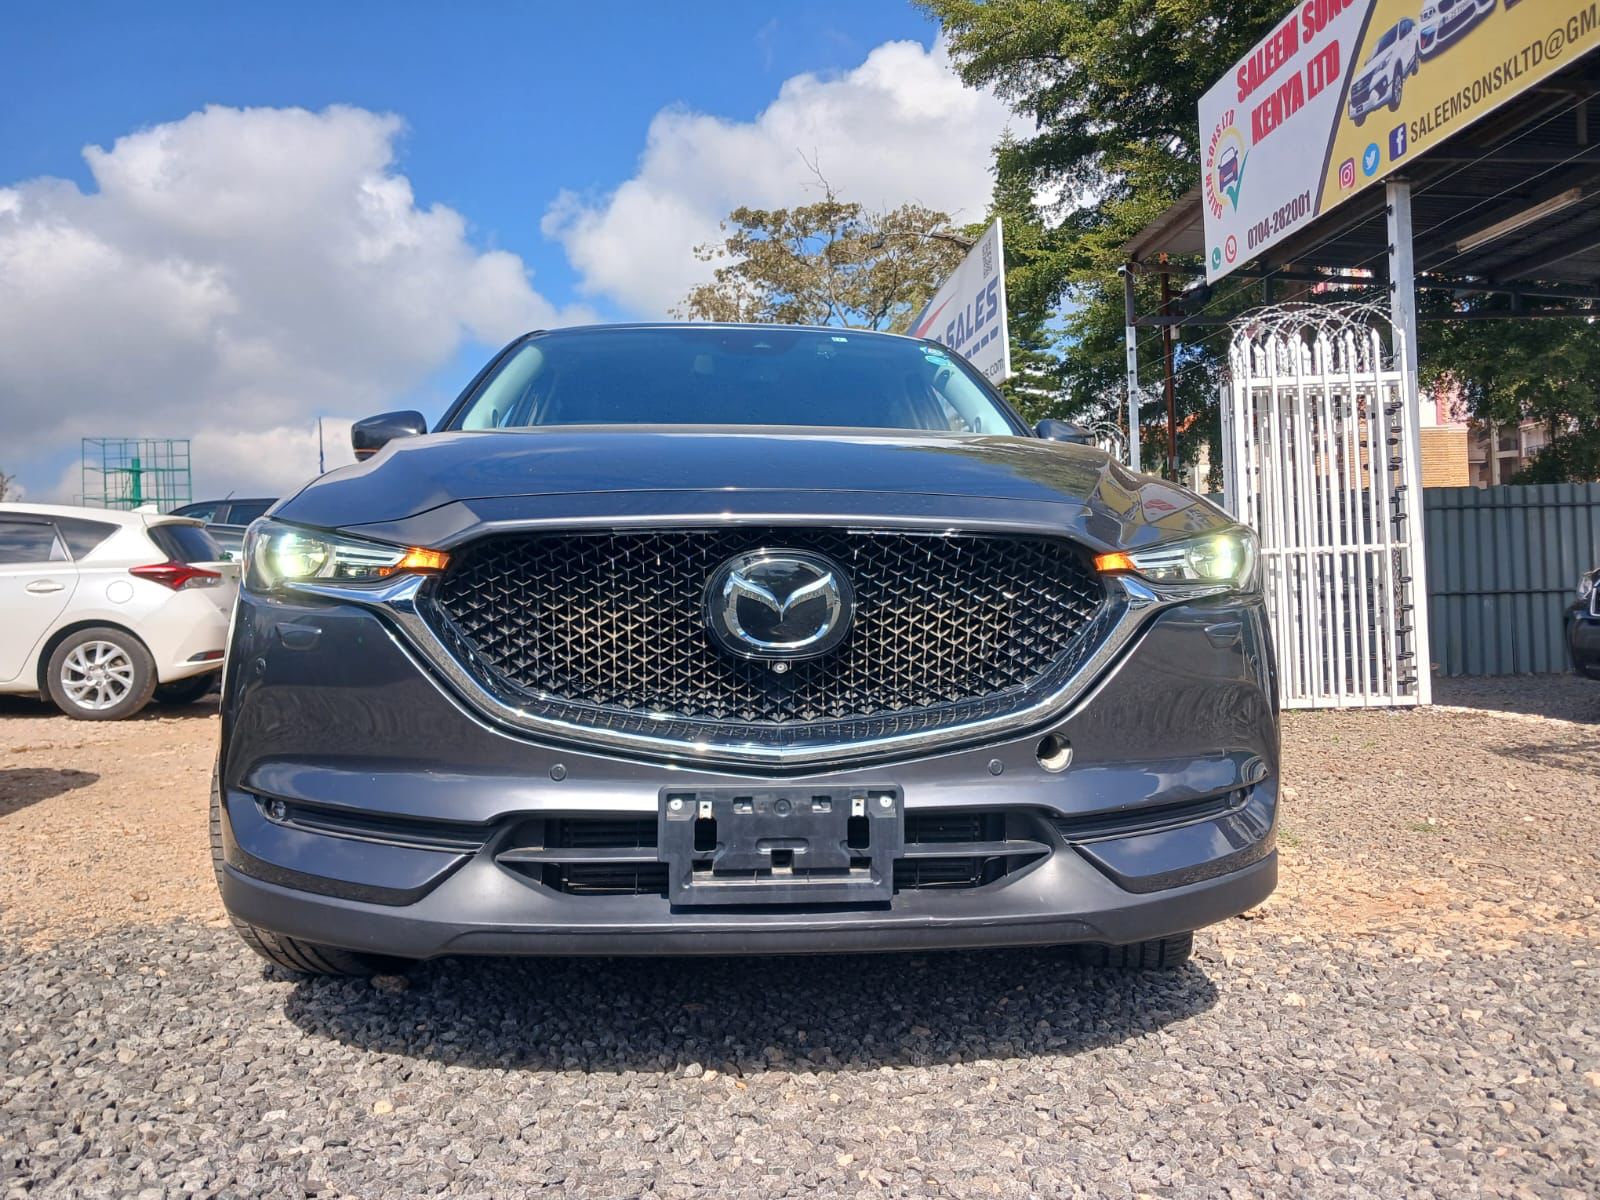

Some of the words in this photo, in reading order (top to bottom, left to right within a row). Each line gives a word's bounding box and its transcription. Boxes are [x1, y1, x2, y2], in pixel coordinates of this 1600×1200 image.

[1237, 14, 1299, 103] SALEEM
[1251, 70, 1305, 146] KENYA
[1307, 39, 1340, 101] LTD
[1410, 2, 1600, 143] SALEEMSONSKLTD@GM
[1206, 123, 1222, 168] SONS
[1221, 109, 1235, 131] LTD
[1247, 189, 1311, 250] 0704-282001
[946, 276, 998, 350] SALES
